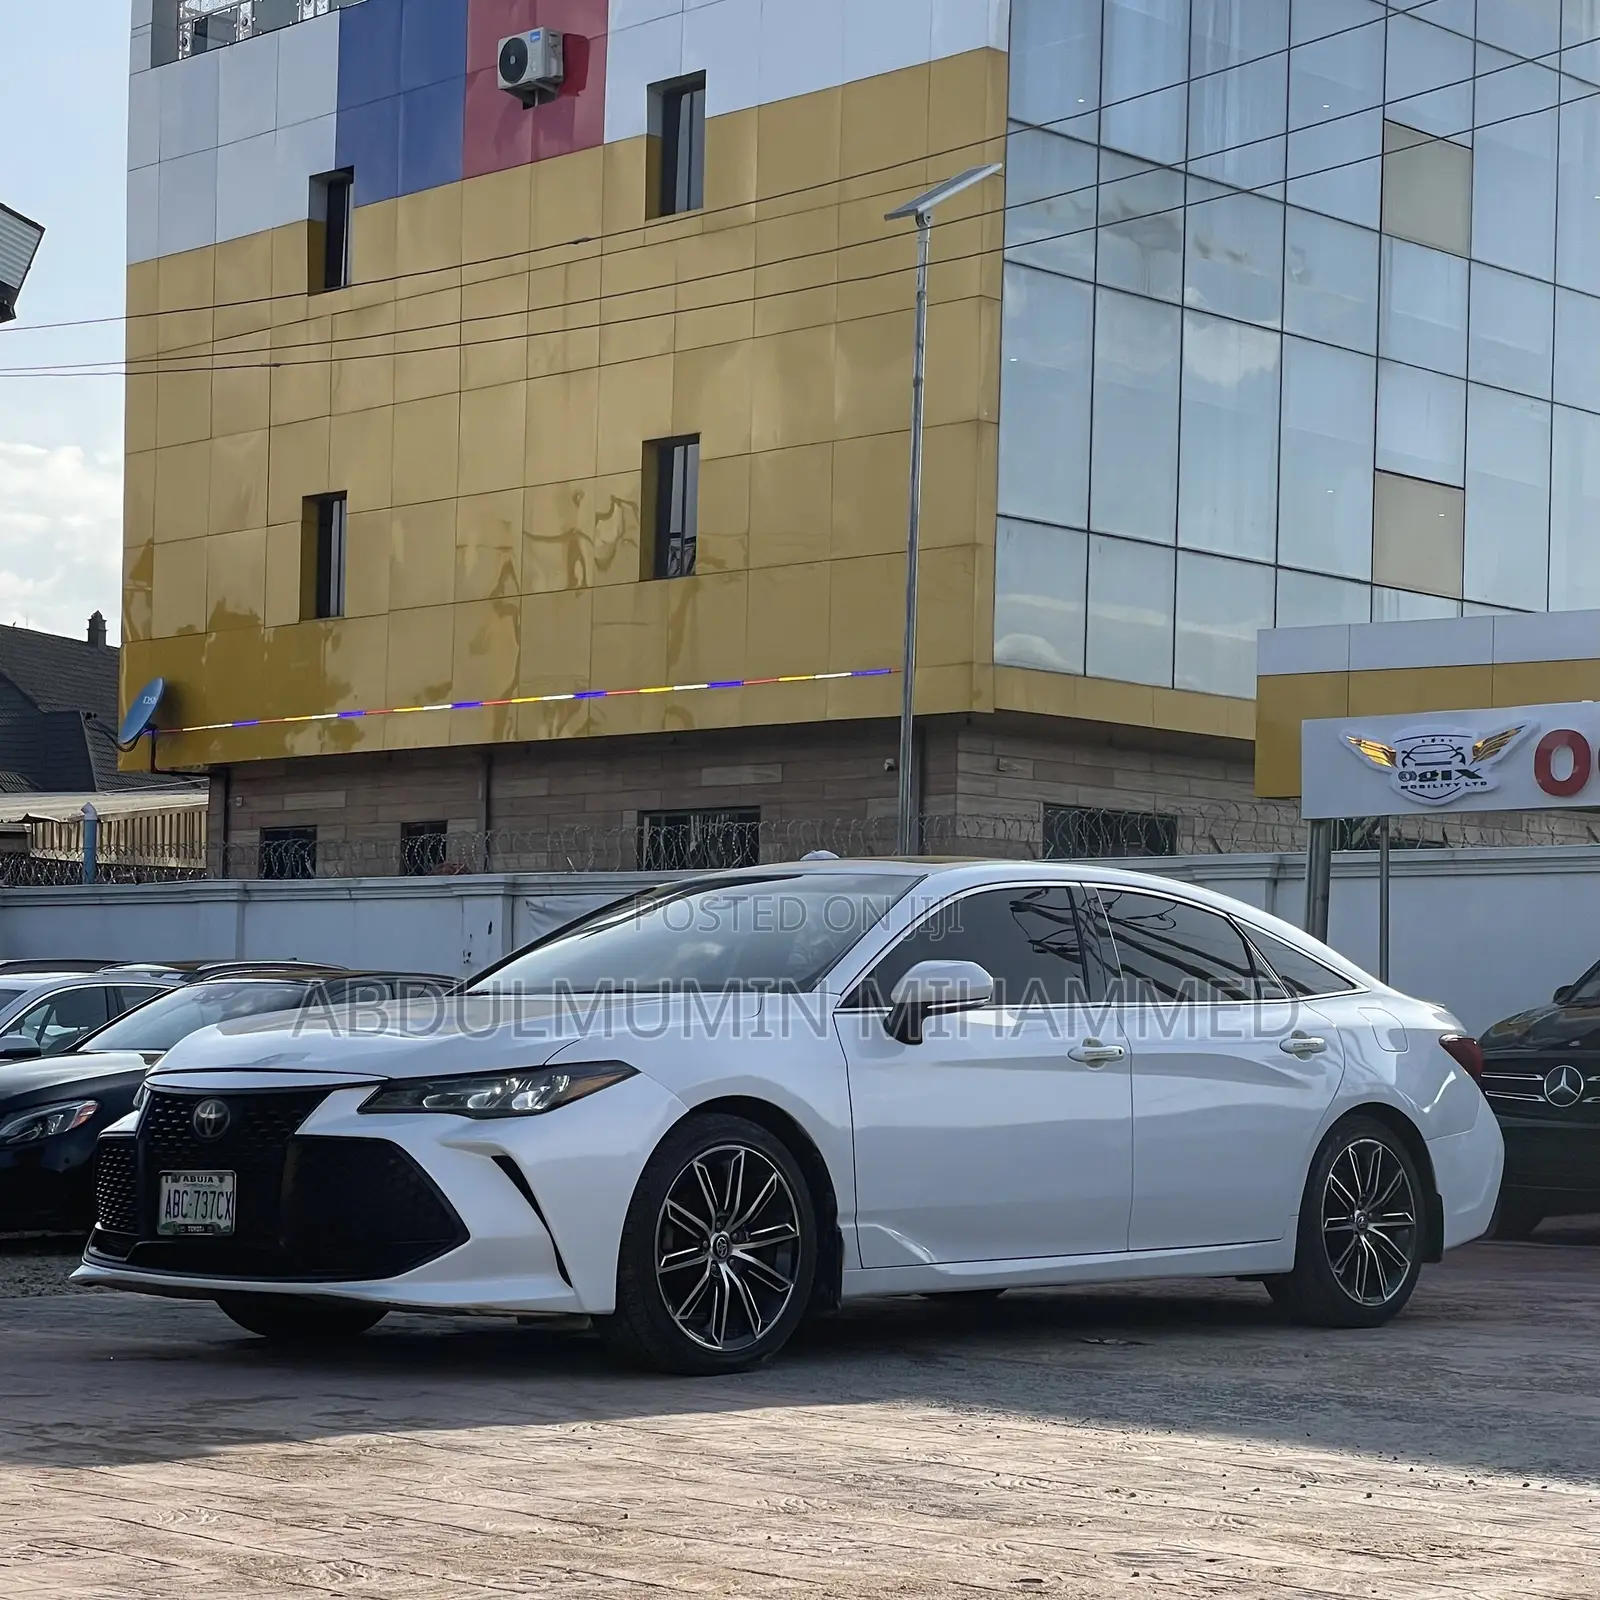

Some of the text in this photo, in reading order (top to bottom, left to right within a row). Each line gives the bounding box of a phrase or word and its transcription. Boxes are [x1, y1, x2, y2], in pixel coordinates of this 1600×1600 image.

[1534, 728, 1600, 797] O
[1400, 782, 1461, 790] MOBILITY
[183, 1175, 214, 1183] ABUJA
